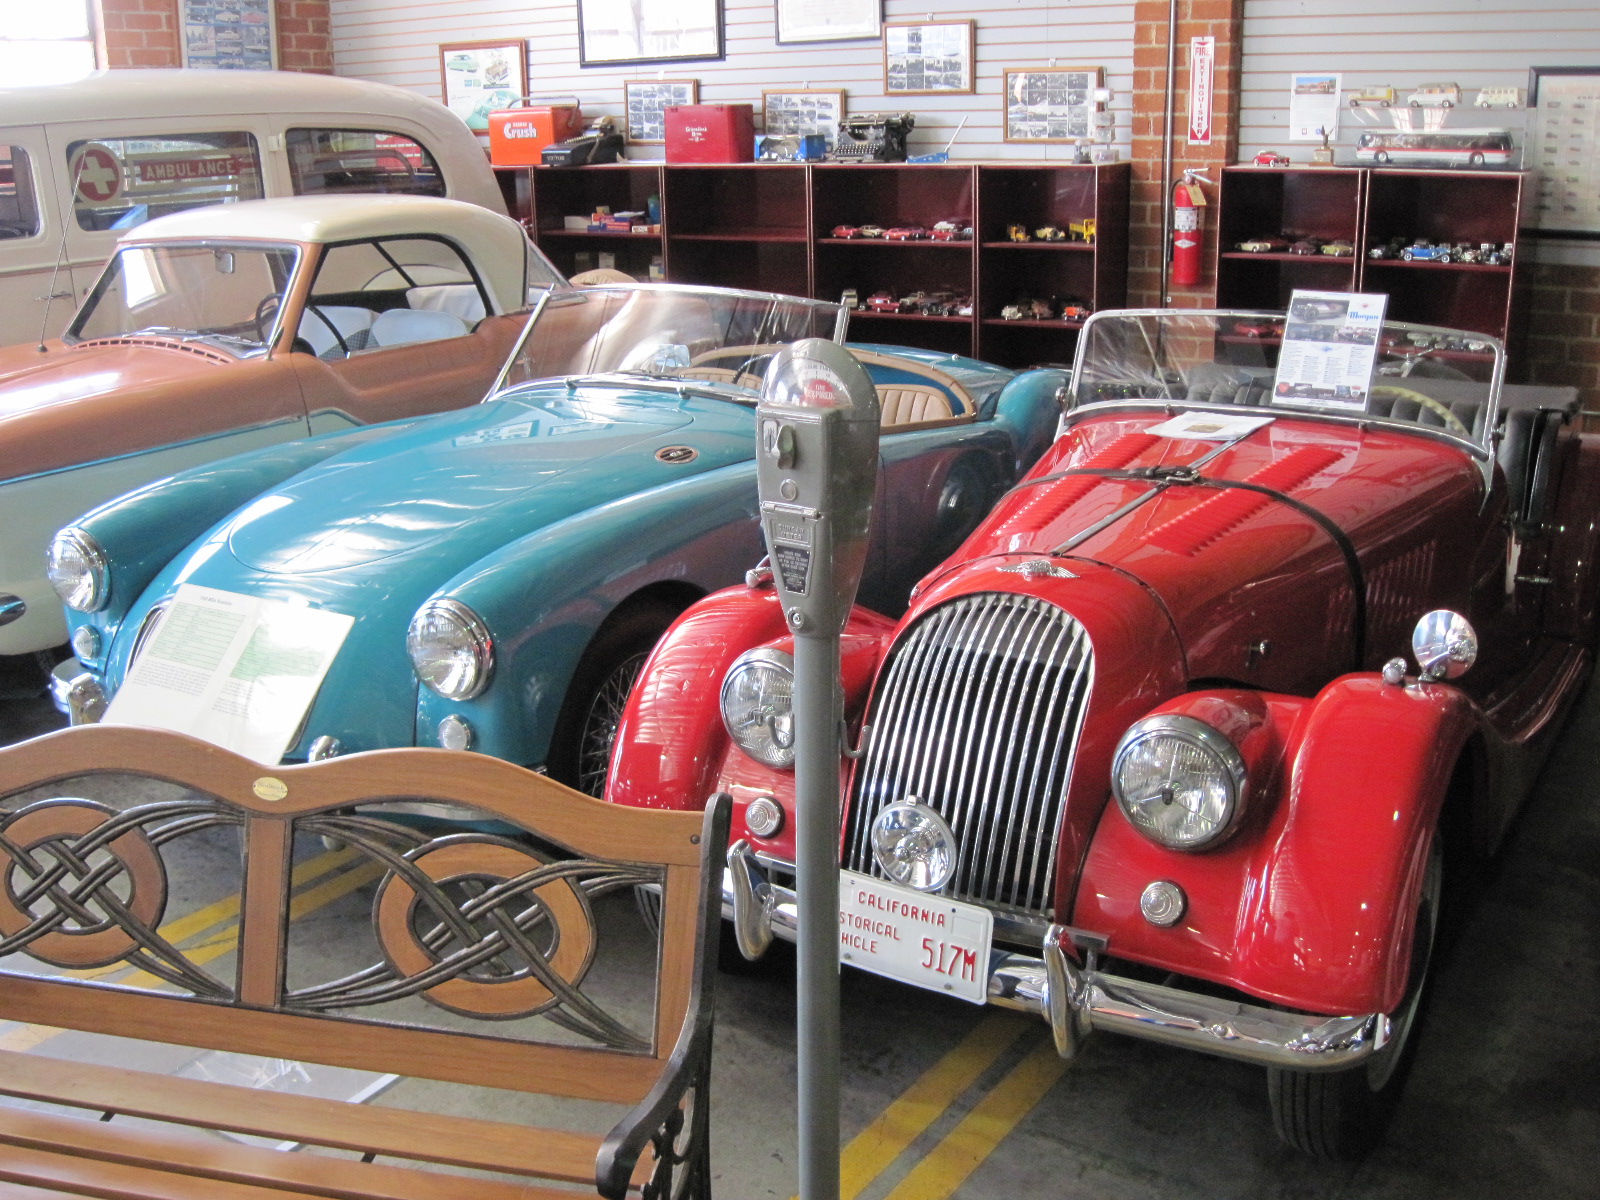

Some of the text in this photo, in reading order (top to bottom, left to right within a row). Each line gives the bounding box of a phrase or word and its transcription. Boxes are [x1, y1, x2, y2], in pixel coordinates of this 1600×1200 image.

[1195, 47, 1209, 56] FIRE
[1197, 59, 1206, 135] EXTINGUISHER
[503, 121, 537, 139] Crush
[146, 159, 236, 179] AMBULANCE
[1348, 311, 1379, 322] Morgan
[858, 891, 945, 926] CALIFORNIA
[839, 911, 901, 941] STORICAL
[840, 932, 878, 954] HICLE
[921, 937, 977, 982] 517M
